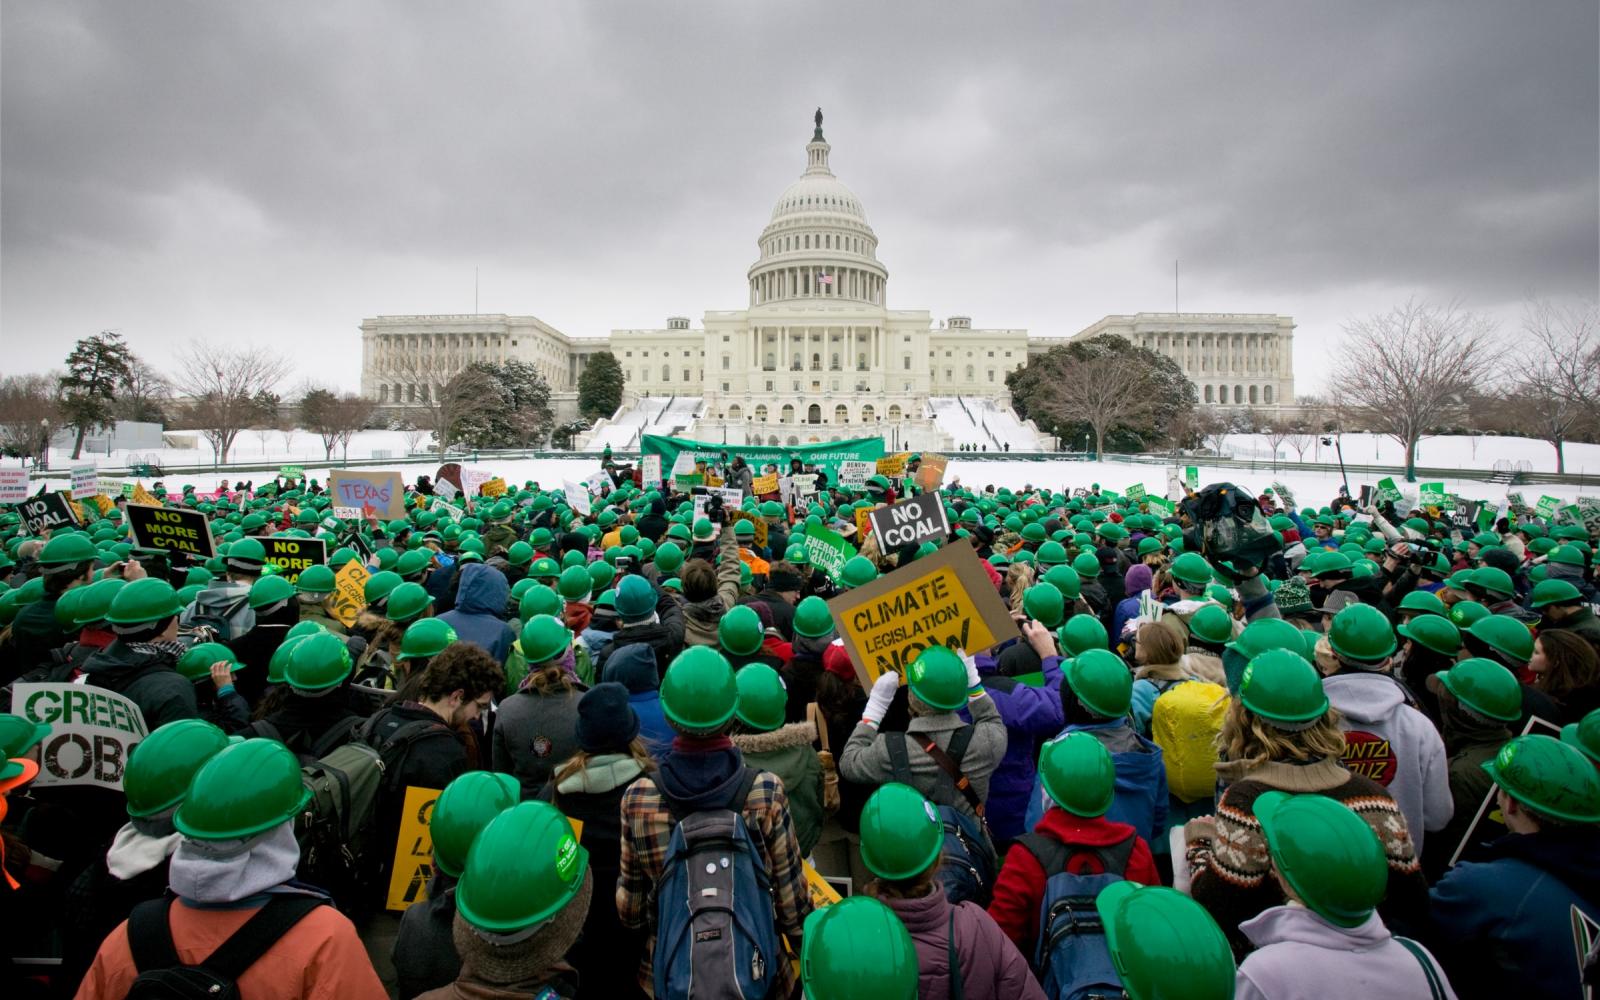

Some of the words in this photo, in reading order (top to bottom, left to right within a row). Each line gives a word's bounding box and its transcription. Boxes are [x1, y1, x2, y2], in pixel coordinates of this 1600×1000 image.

[829, 452, 860, 460] FUTURE
[340, 483, 390, 503] TEXAS
[25, 501, 48, 518] NO
[154, 511, 182, 523] NO
[891, 503, 922, 525] NO
[1456, 505, 1467, 515] NO
[27, 511, 70, 532] COAL
[145, 523, 199, 539] MORE
[885, 517, 942, 546] COAL
[153, 537, 201, 552] COAL
[274, 542, 300, 554] NO
[804, 535, 839, 557] ENERGY
[265, 556, 313, 570] MORE
[853, 575, 950, 633] CLIMATE
[864, 602, 959, 654] LEGISLATION
[25, 690, 145, 738] GREEN
[1341, 741, 1390, 759] ANTA
